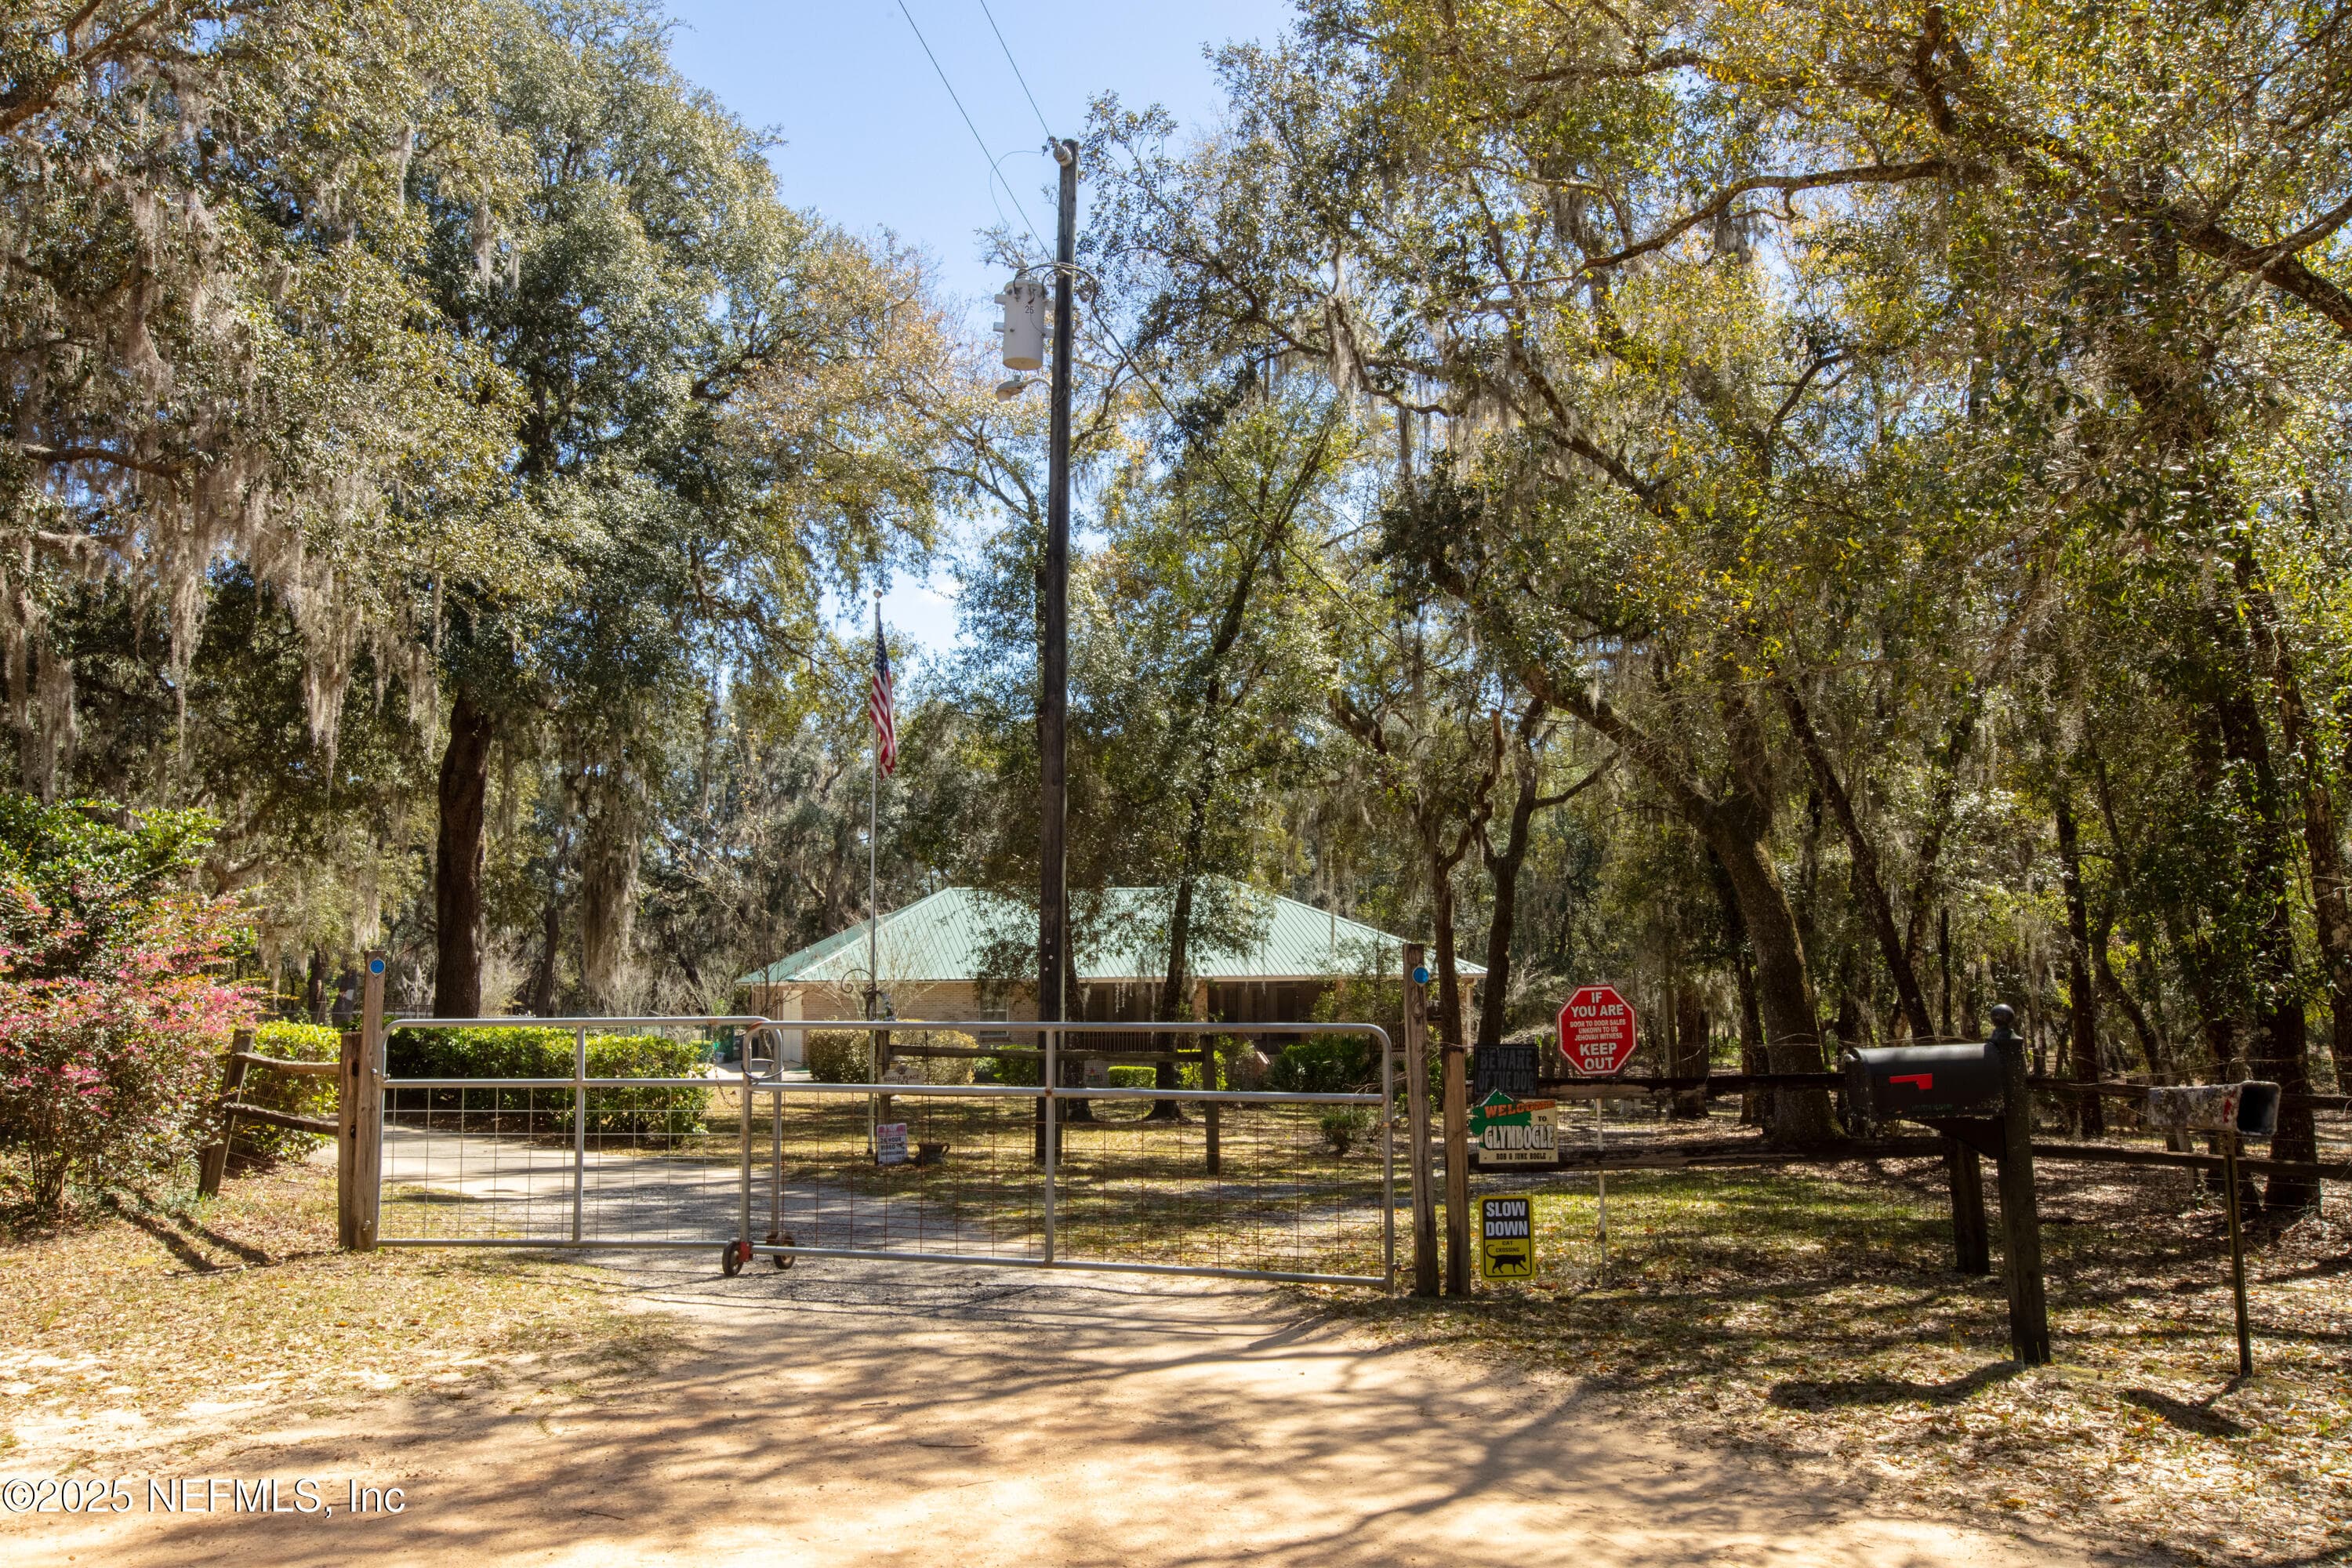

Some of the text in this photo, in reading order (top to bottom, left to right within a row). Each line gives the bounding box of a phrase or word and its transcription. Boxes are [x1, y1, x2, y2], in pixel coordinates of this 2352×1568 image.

[1025, 305, 1034, 314] 25
[1591, 992, 1602, 1004] IF
[1570, 1004, 1624, 1018] YOU ARE
[1579, 1042, 1617, 1056] KEEP
[1479, 1049, 1533, 1069] BEWARE
[1584, 1057, 1614, 1070] OUT
[1478, 1070, 1534, 1091] OF THE DOG
[1484, 1124, 1555, 1150] GLYNBOGLE
[1486, 1201, 1526, 1217] SLOW
[1485, 1221, 1528, 1236] DOWN
